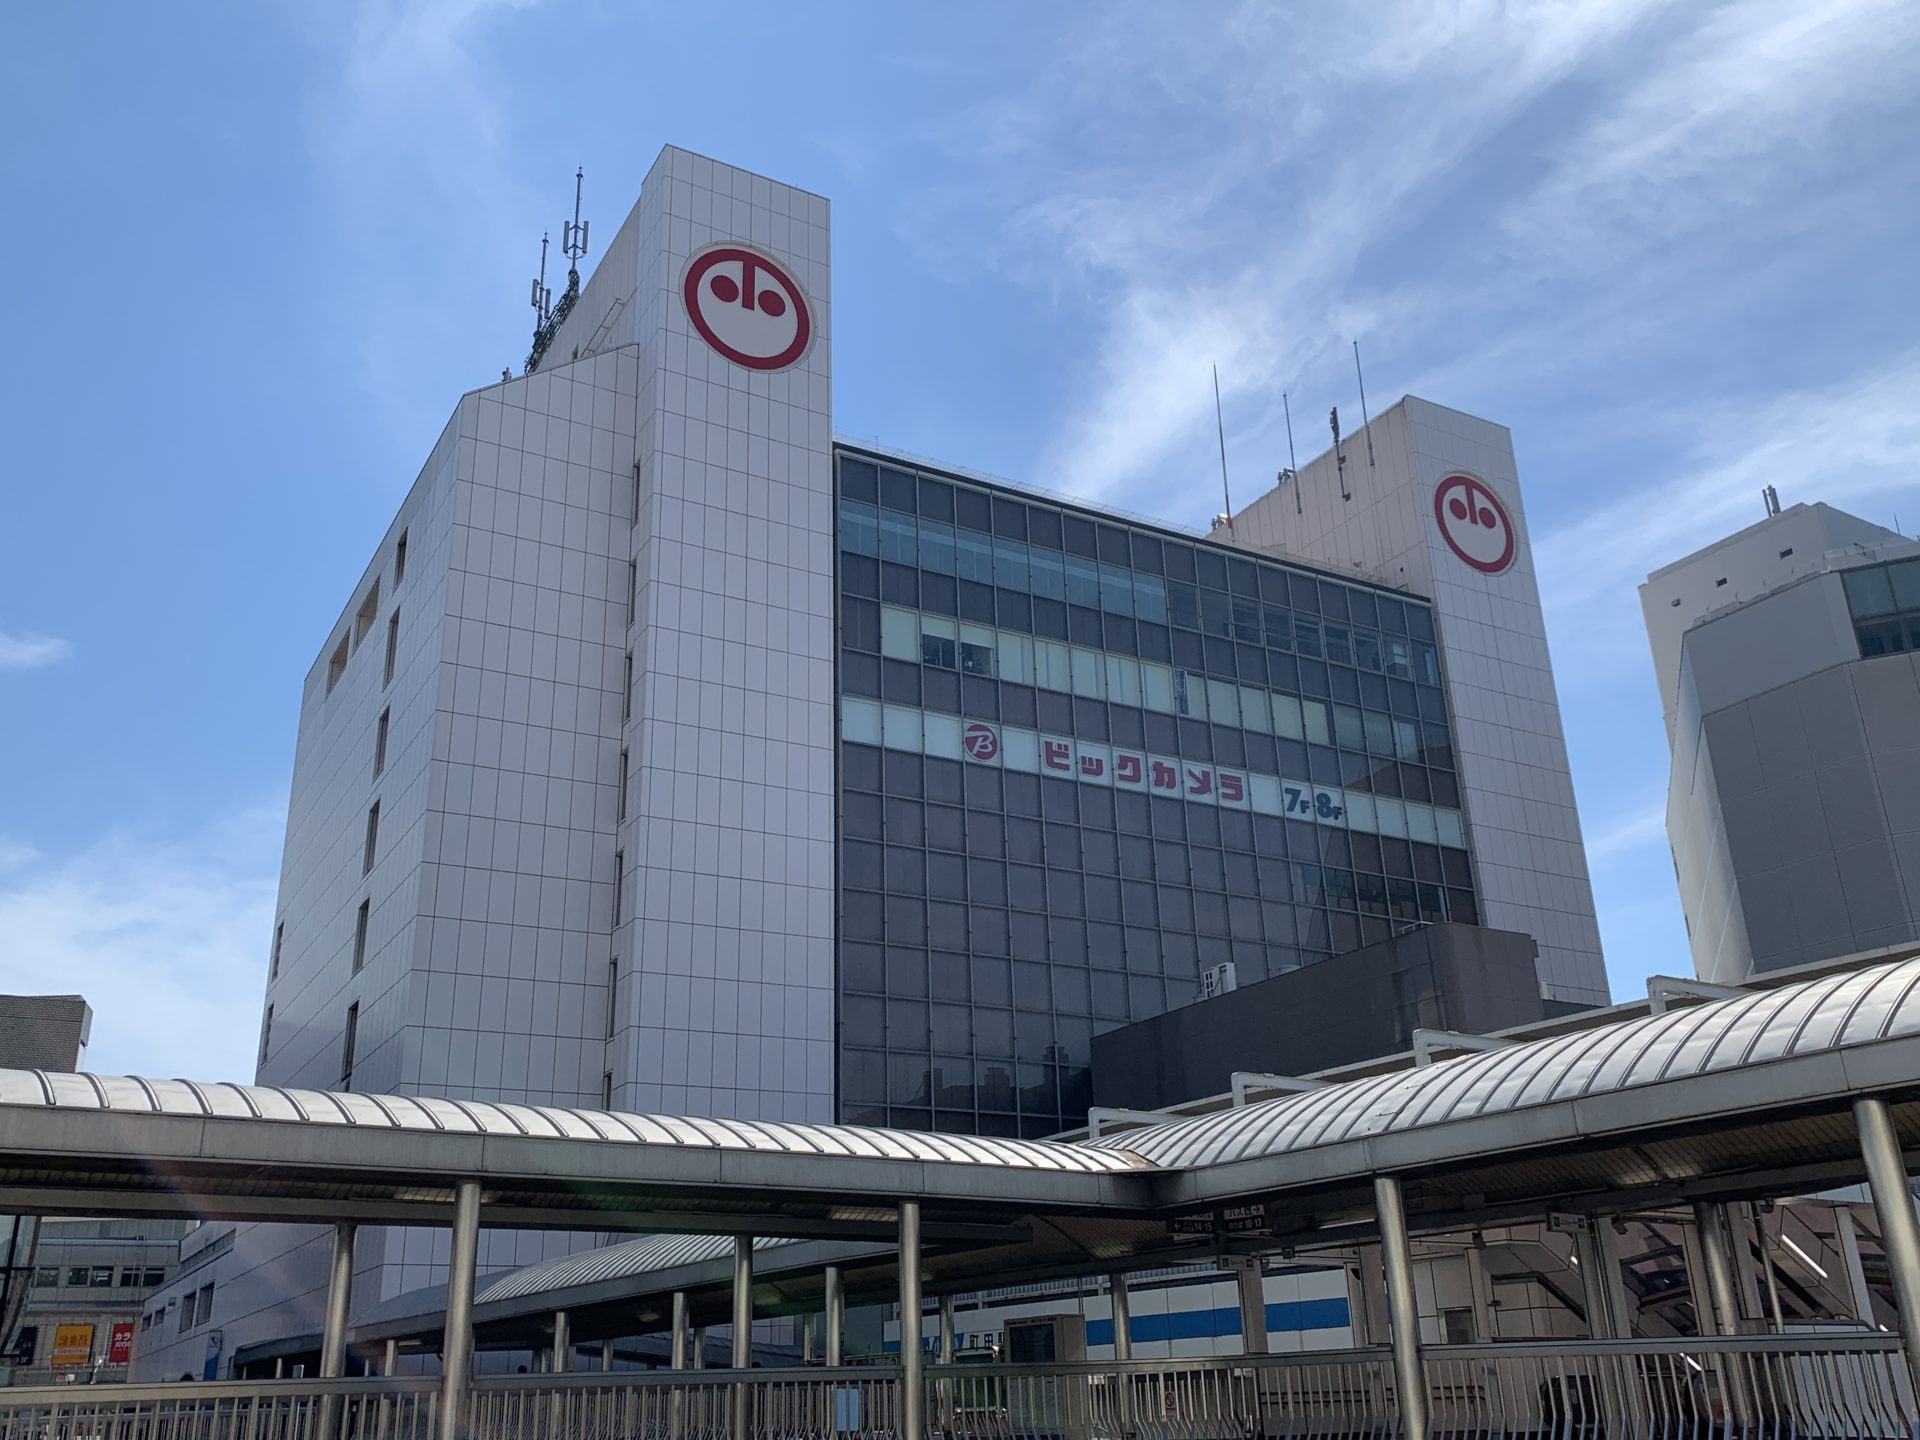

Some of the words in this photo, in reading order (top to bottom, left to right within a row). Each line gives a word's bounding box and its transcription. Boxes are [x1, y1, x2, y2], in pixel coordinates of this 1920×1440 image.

[964, 727, 996, 758] B
[1044, 740, 1244, 801] ビックカメラ
[1284, 787, 1310, 814] 7F
[1316, 792, 1342, 820] 8F
